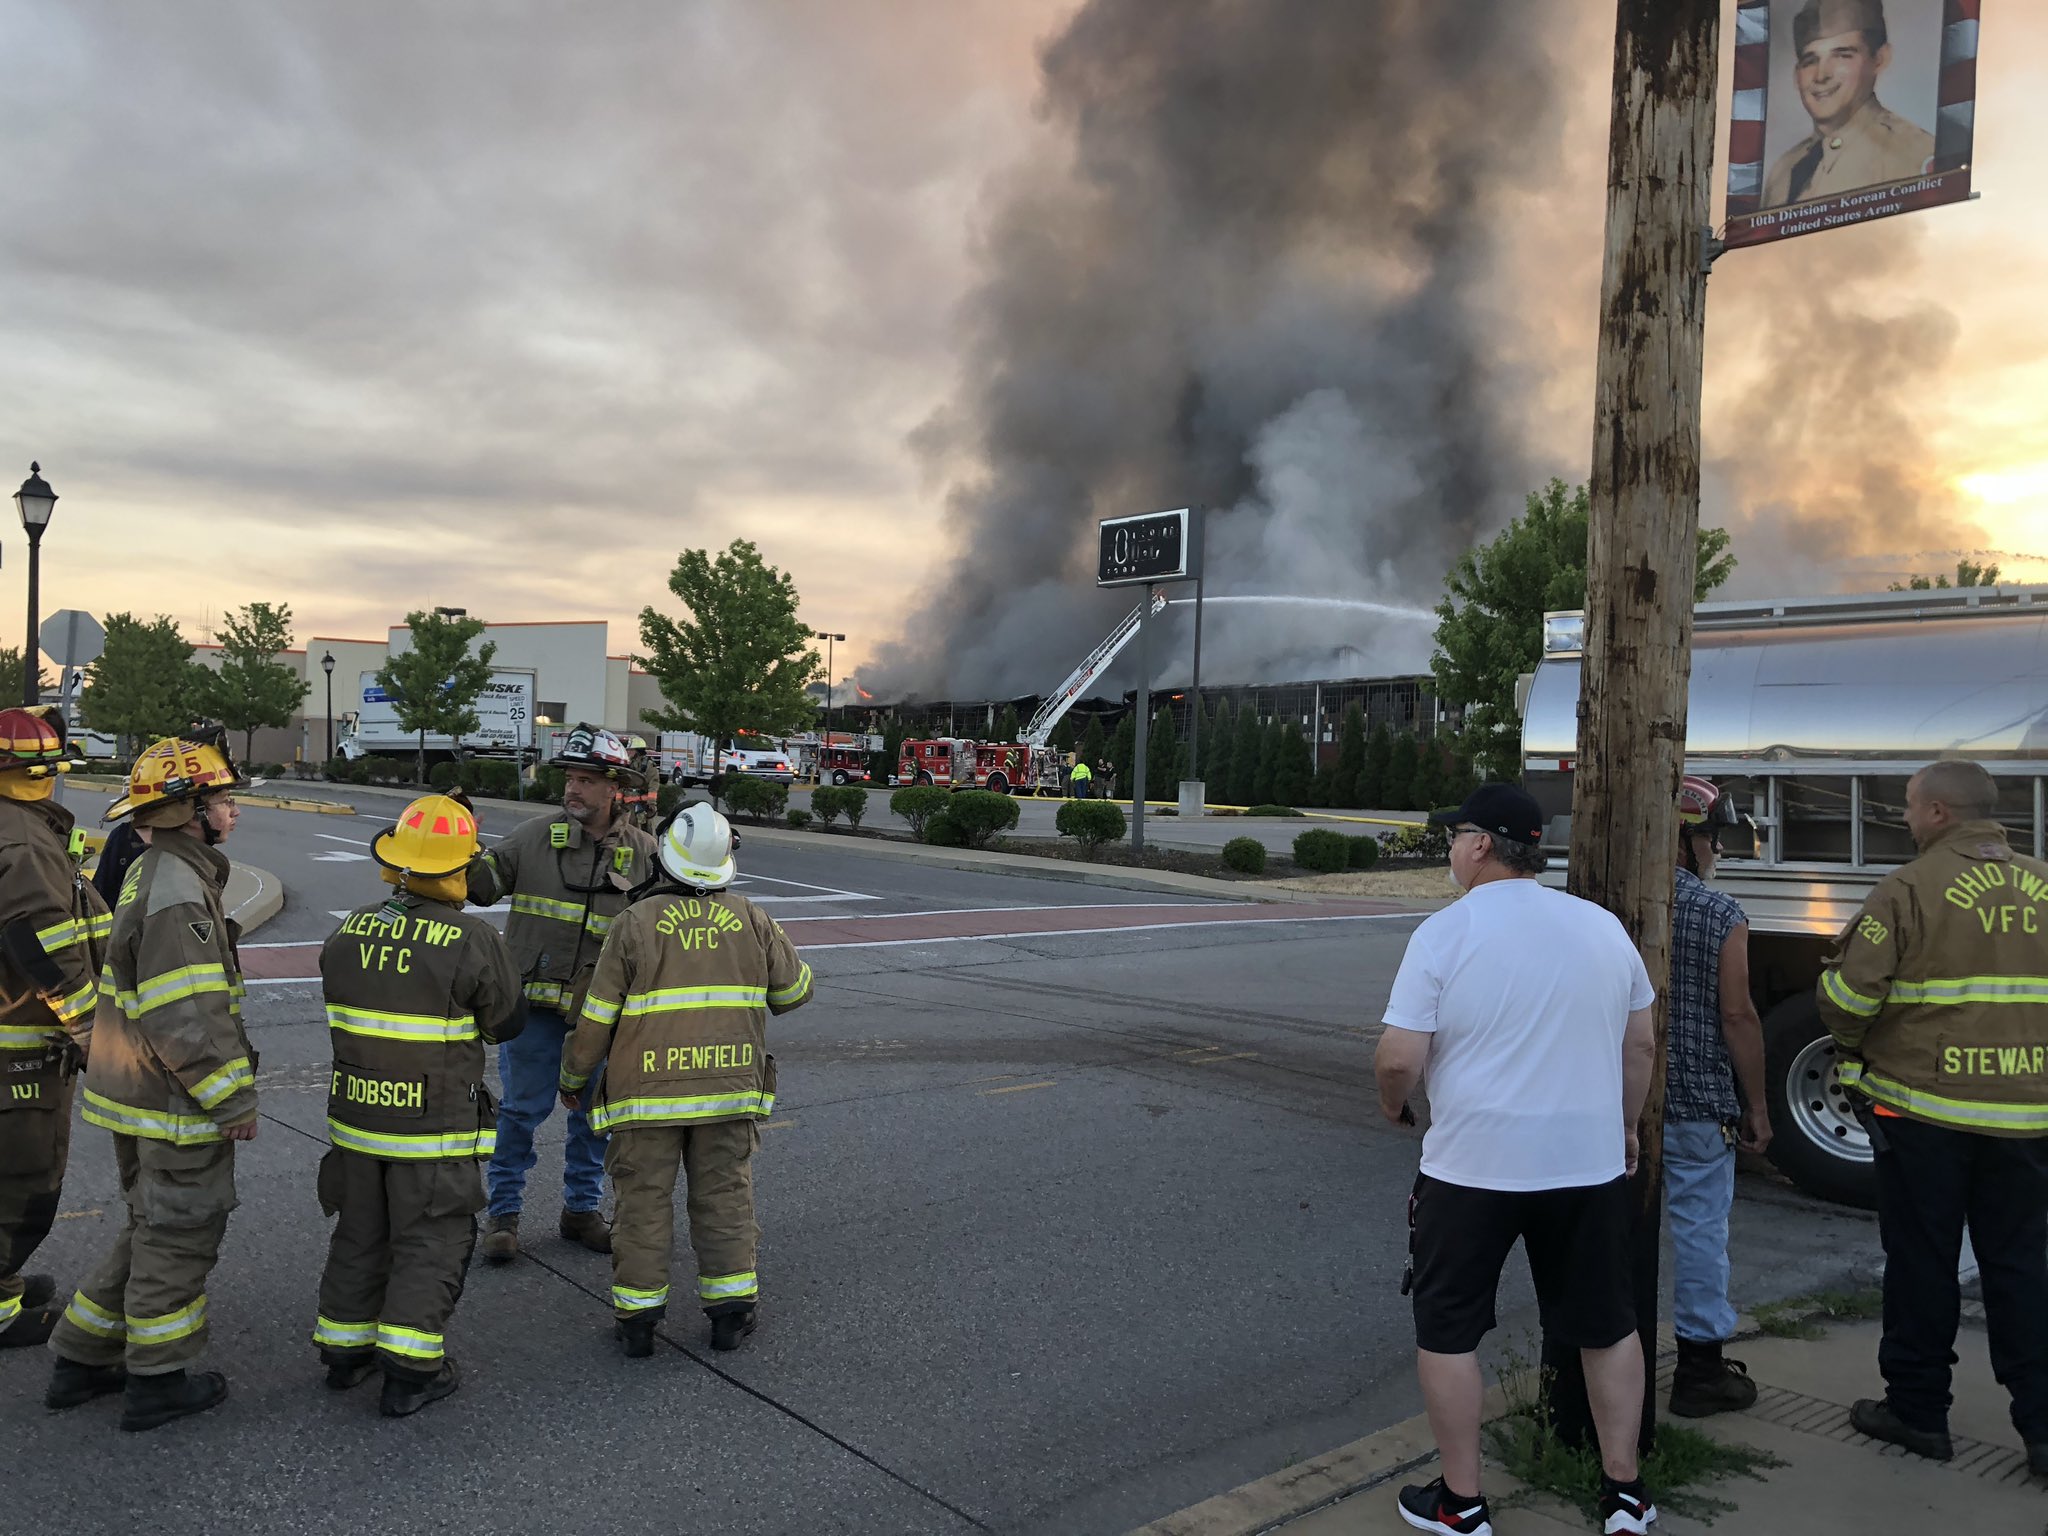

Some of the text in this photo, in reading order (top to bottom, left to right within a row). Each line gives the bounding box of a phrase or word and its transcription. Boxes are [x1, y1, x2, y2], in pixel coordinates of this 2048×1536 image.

[1750, 216, 1775, 228] 10th
[1779, 204, 1828, 222] Division
[1840, 189, 1886, 209] Korean
[1890, 177, 1942, 197] Conflict
[1780, 202, 1903, 235] United States Army
[484, 683, 524, 693] NSKE
[510, 707, 526, 720] 25
[162, 757, 201, 779] 25
[1945, 862, 2006, 910] OHIO
[412, 917, 462, 947] TWP
[656, 899, 702, 935] OHIO
[707, 901, 743, 933] TWP
[1856, 914, 1889, 945] 220
[1977, 905, 2038, 934] VFC
[678, 927, 719, 950] VFC
[359, 943, 412, 974] VFC
[643, 1043, 753, 1073] R. PENFIELD
[1944, 1046, 2048, 1075] STEWAR
[346, 1074, 423, 1108] DOBSCH
